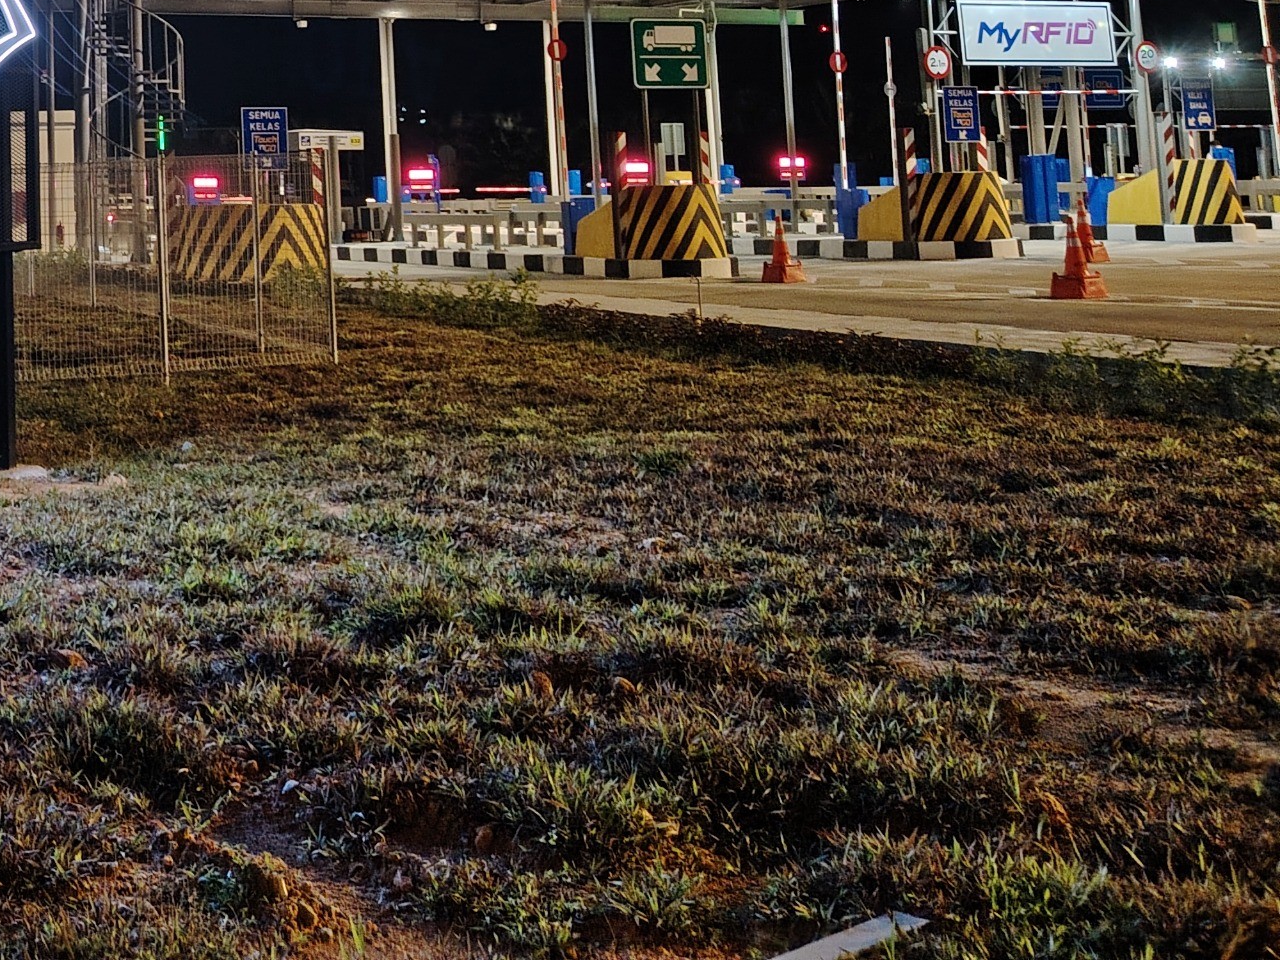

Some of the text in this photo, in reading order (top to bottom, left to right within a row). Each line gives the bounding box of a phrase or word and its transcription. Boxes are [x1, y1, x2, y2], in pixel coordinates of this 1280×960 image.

[1140, 49, 1154, 59] 20
[949, 99, 973, 107] KELAS
[248, 111, 280, 120] SEMUA
[249, 122, 280, 131] KELAS
